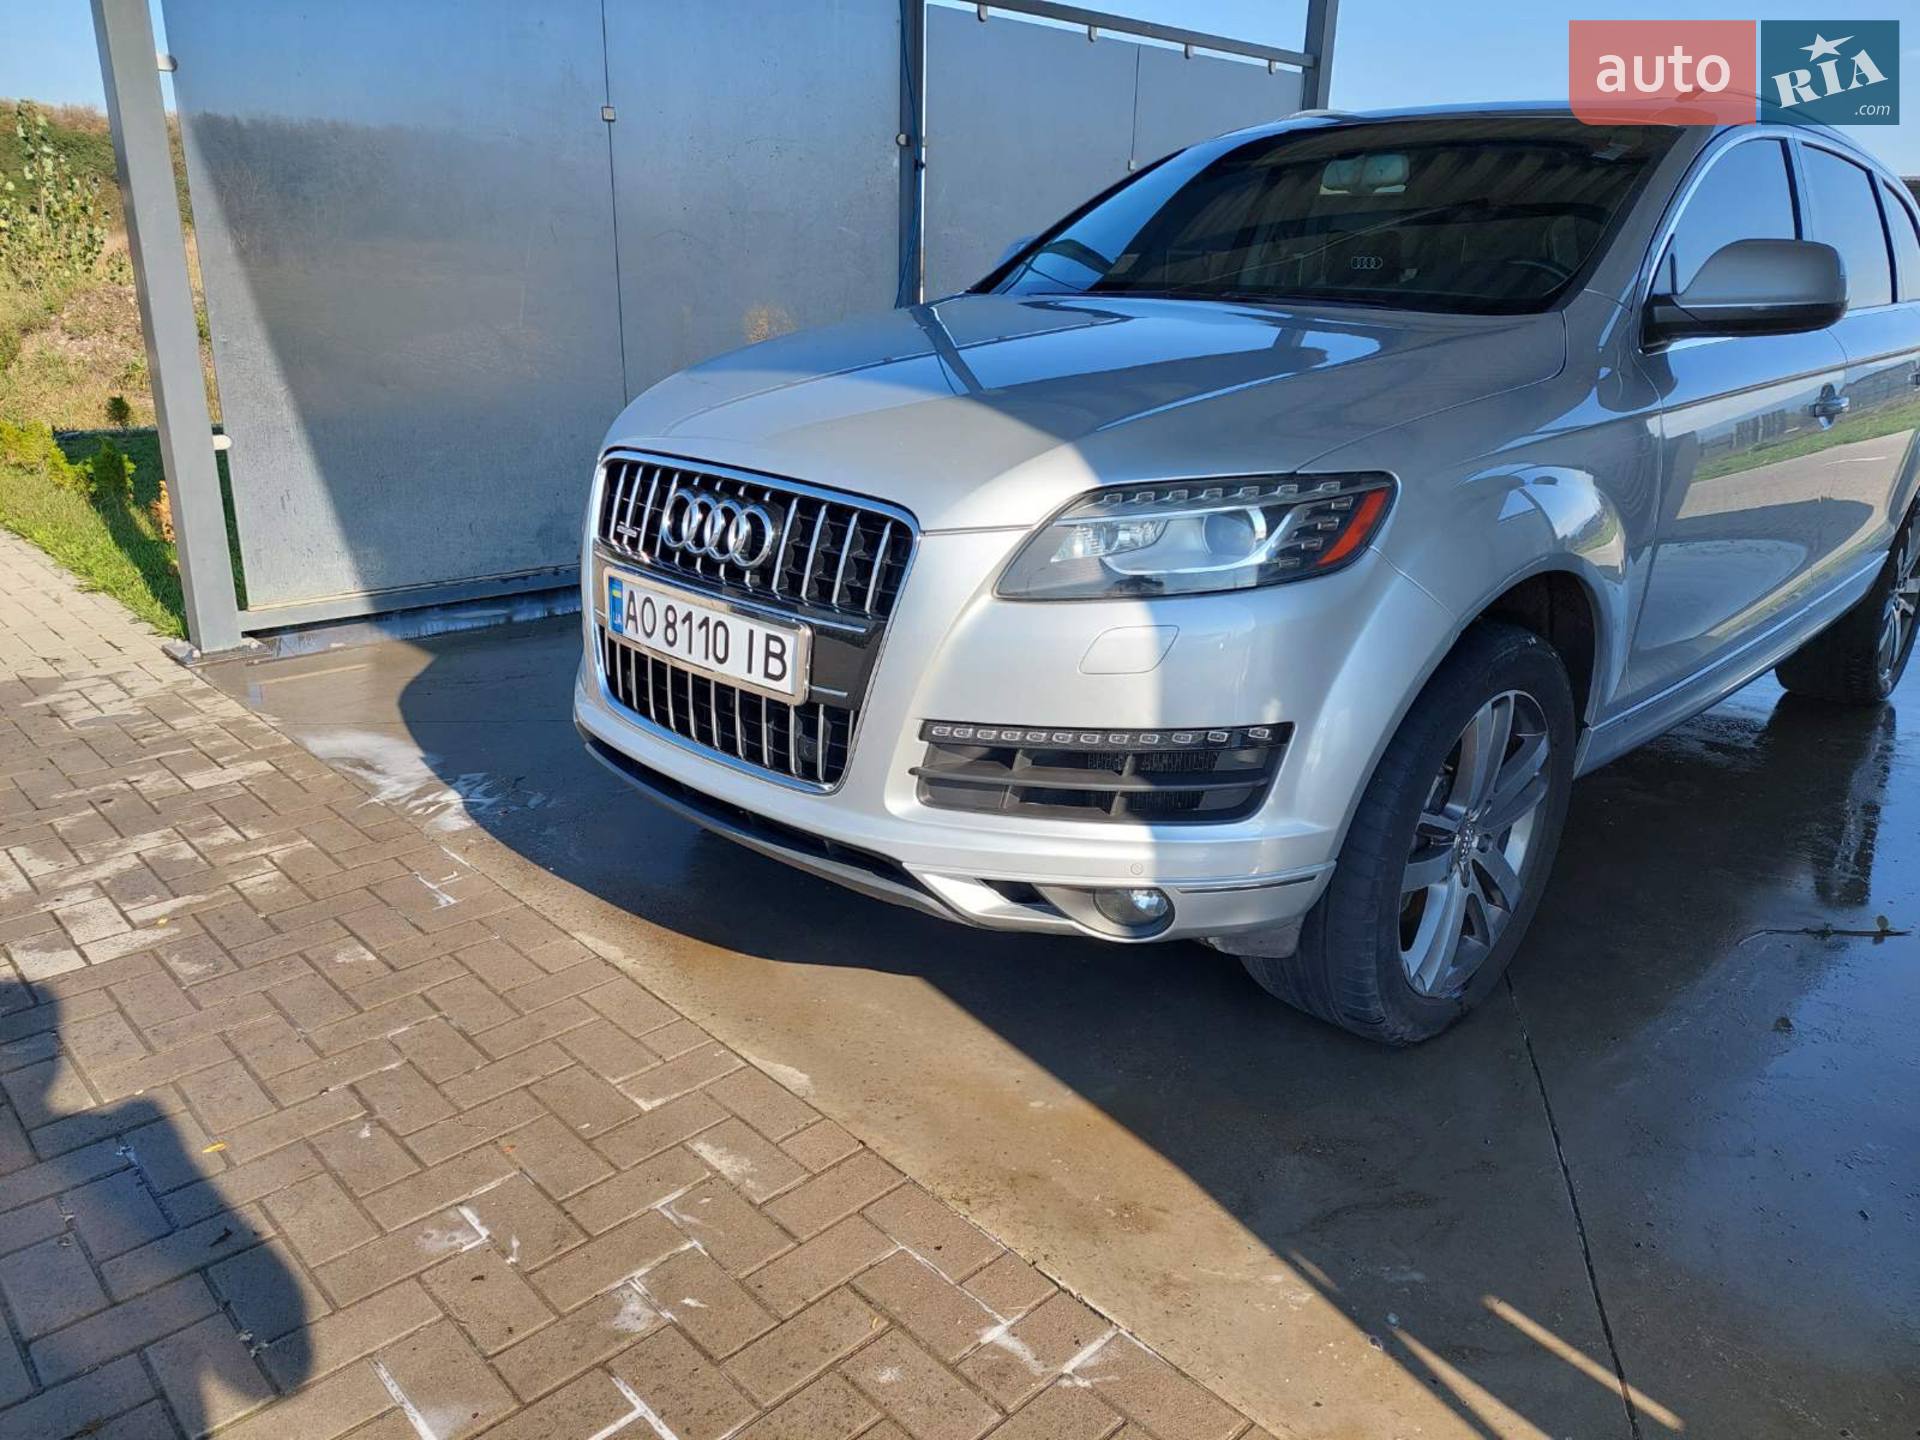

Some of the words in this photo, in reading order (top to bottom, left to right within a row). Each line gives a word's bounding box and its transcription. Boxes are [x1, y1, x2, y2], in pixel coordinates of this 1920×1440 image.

[625, 590, 657, 639] AO
[664, 604, 730, 665] 8110
[747, 628, 788, 682] IB
